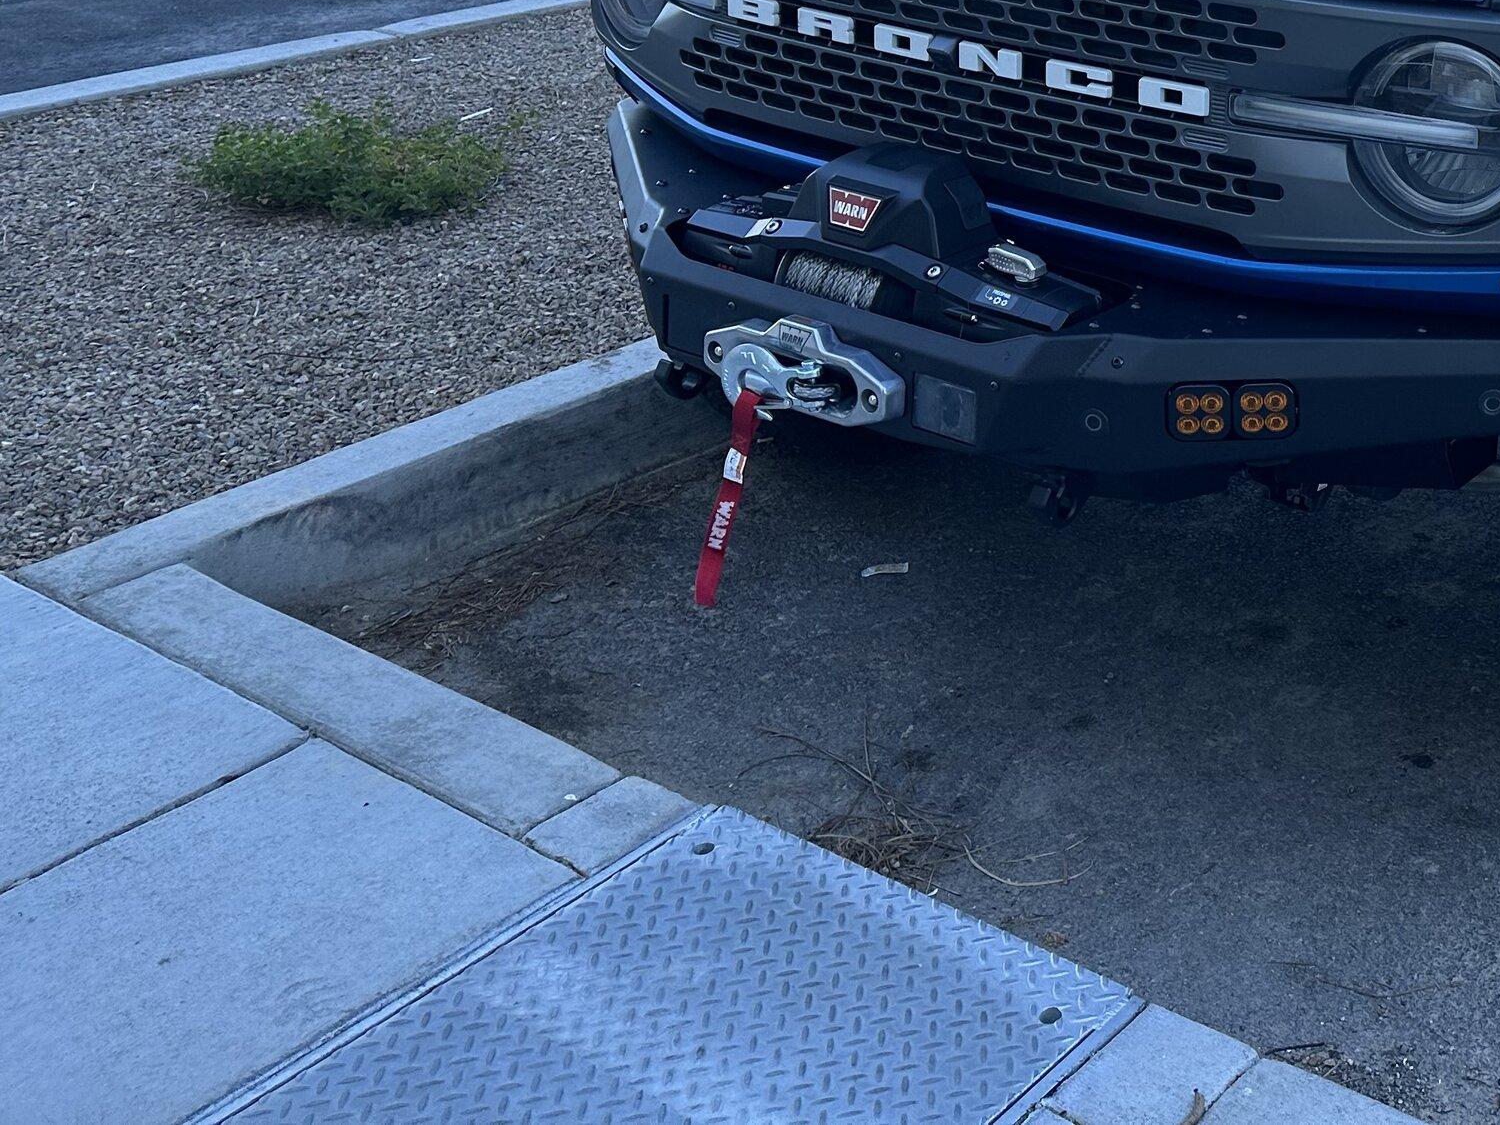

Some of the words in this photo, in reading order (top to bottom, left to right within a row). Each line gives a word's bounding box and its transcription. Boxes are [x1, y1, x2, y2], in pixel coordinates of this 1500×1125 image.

[833, 199, 869, 222] WARN
[781, 331, 804, 344] WARN
[707, 500, 735, 551] WARN
